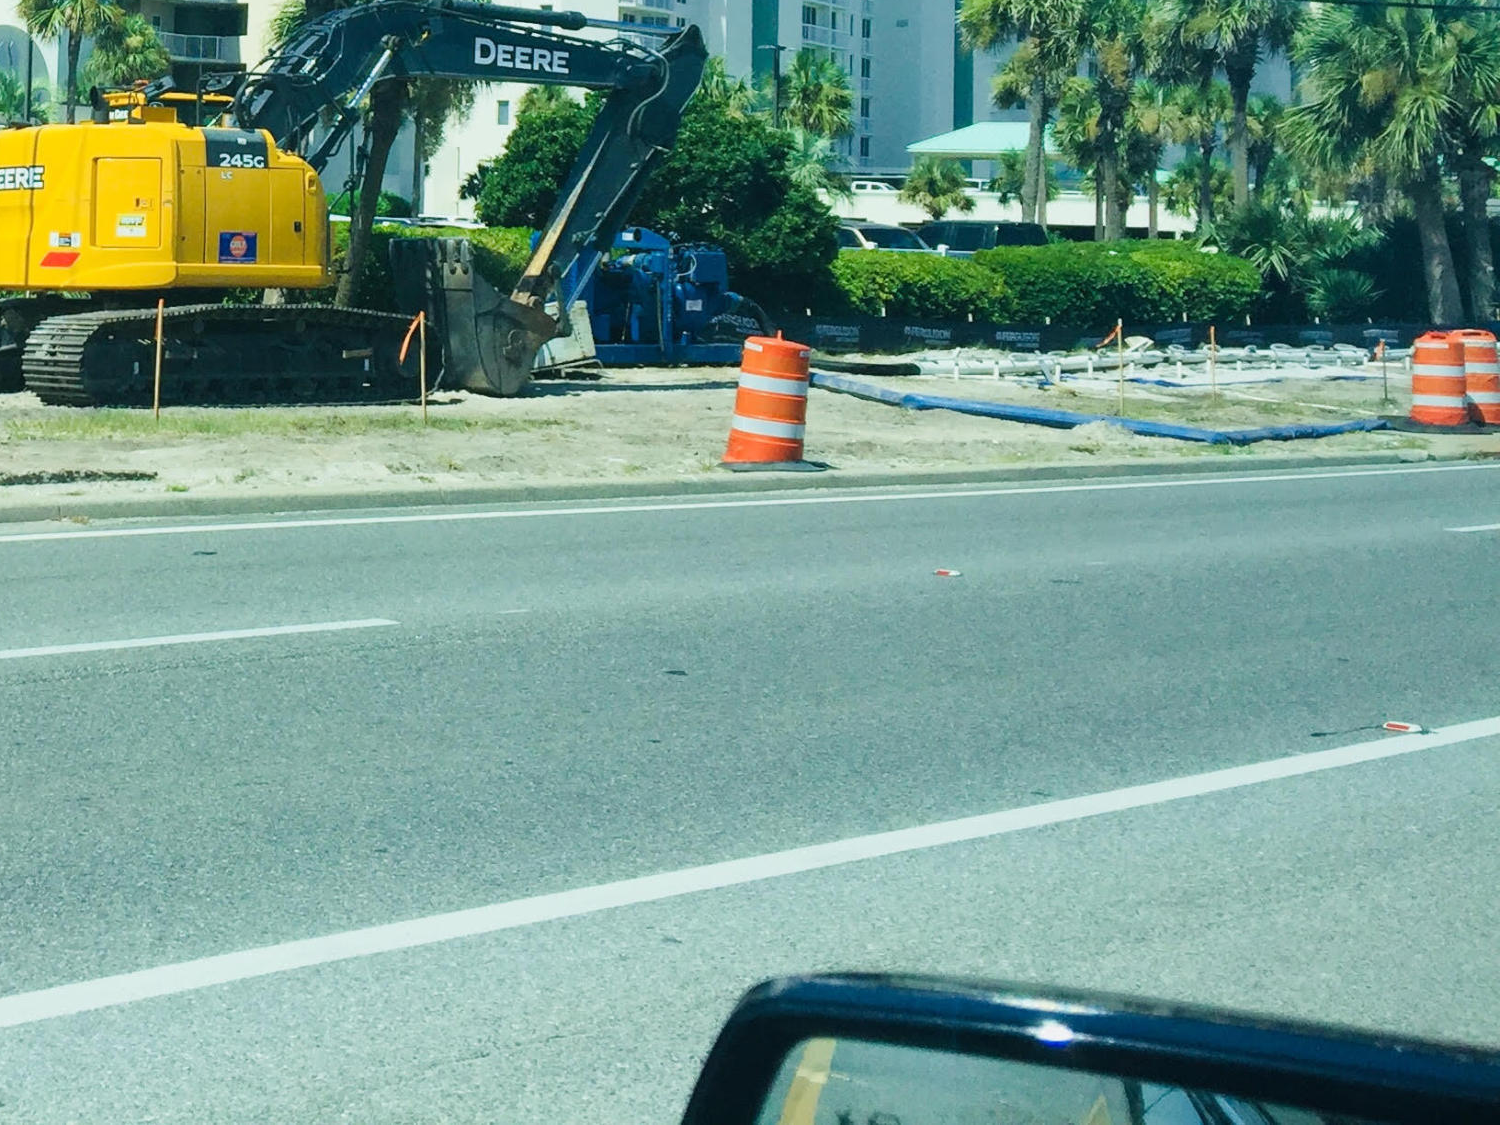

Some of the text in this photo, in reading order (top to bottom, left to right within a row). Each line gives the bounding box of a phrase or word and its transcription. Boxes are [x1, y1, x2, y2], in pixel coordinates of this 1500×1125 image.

[474, 36, 569, 74] DEERE
[219, 153, 265, 168] 245G
[221, 171, 233, 180] LC
